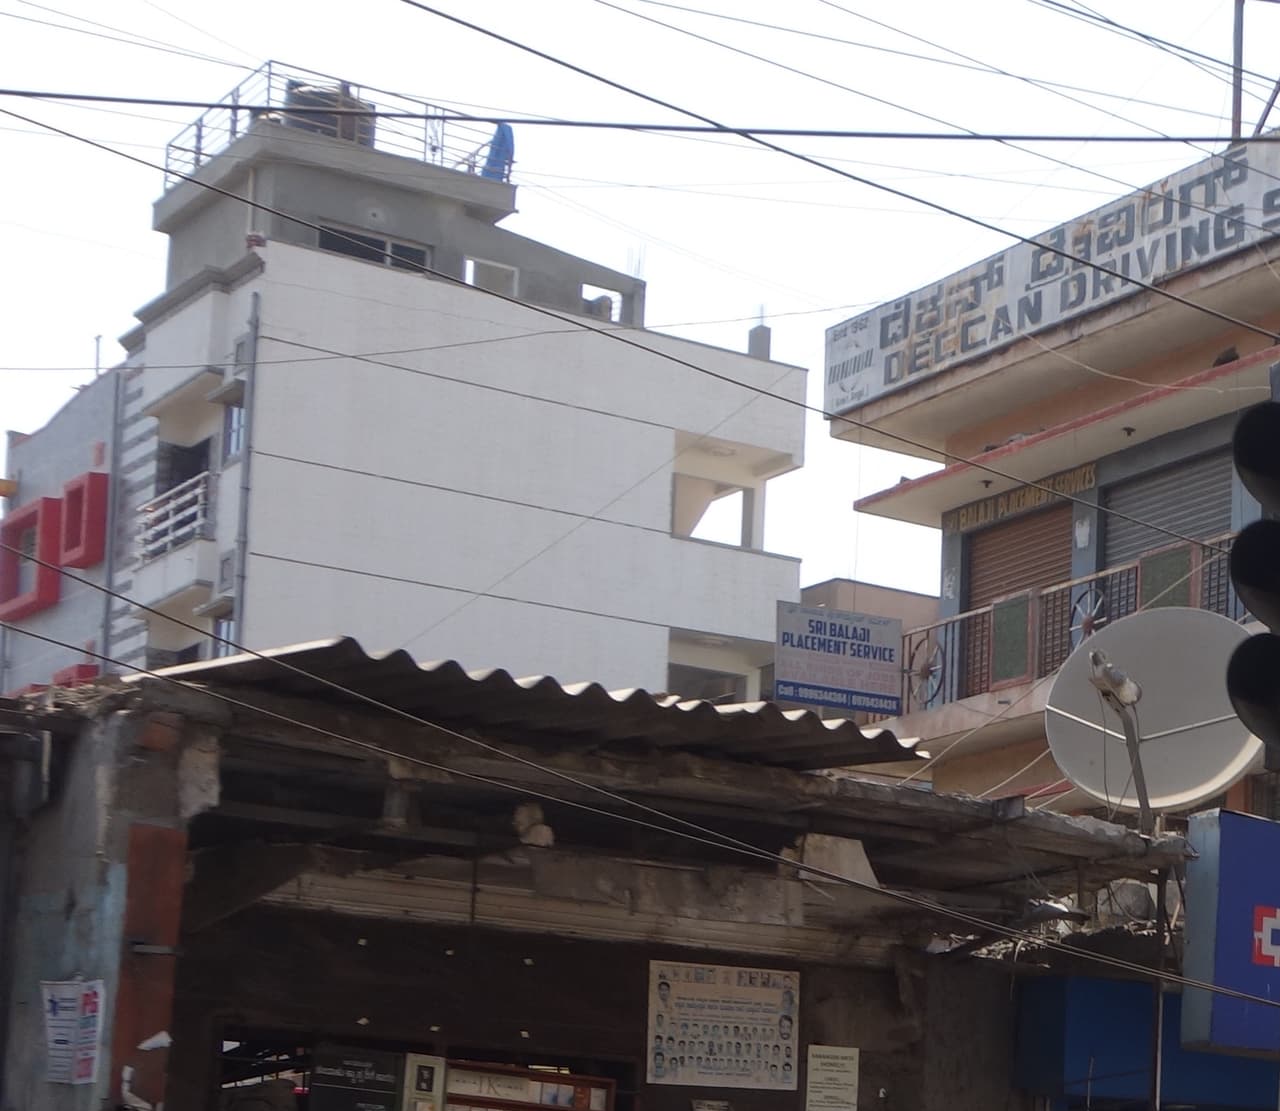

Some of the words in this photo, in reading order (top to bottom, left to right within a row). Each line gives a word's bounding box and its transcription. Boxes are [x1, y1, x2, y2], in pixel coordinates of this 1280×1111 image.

[884, 289, 1043, 385] DECCAN
[1060, 203, 1245, 313] DRIVING
[808, 618, 827, 637] SRI
[829, 623, 871, 643] BALAJI
[782, 631, 847, 656] PLACEMENT
[850, 641, 895, 663] SERVICE
